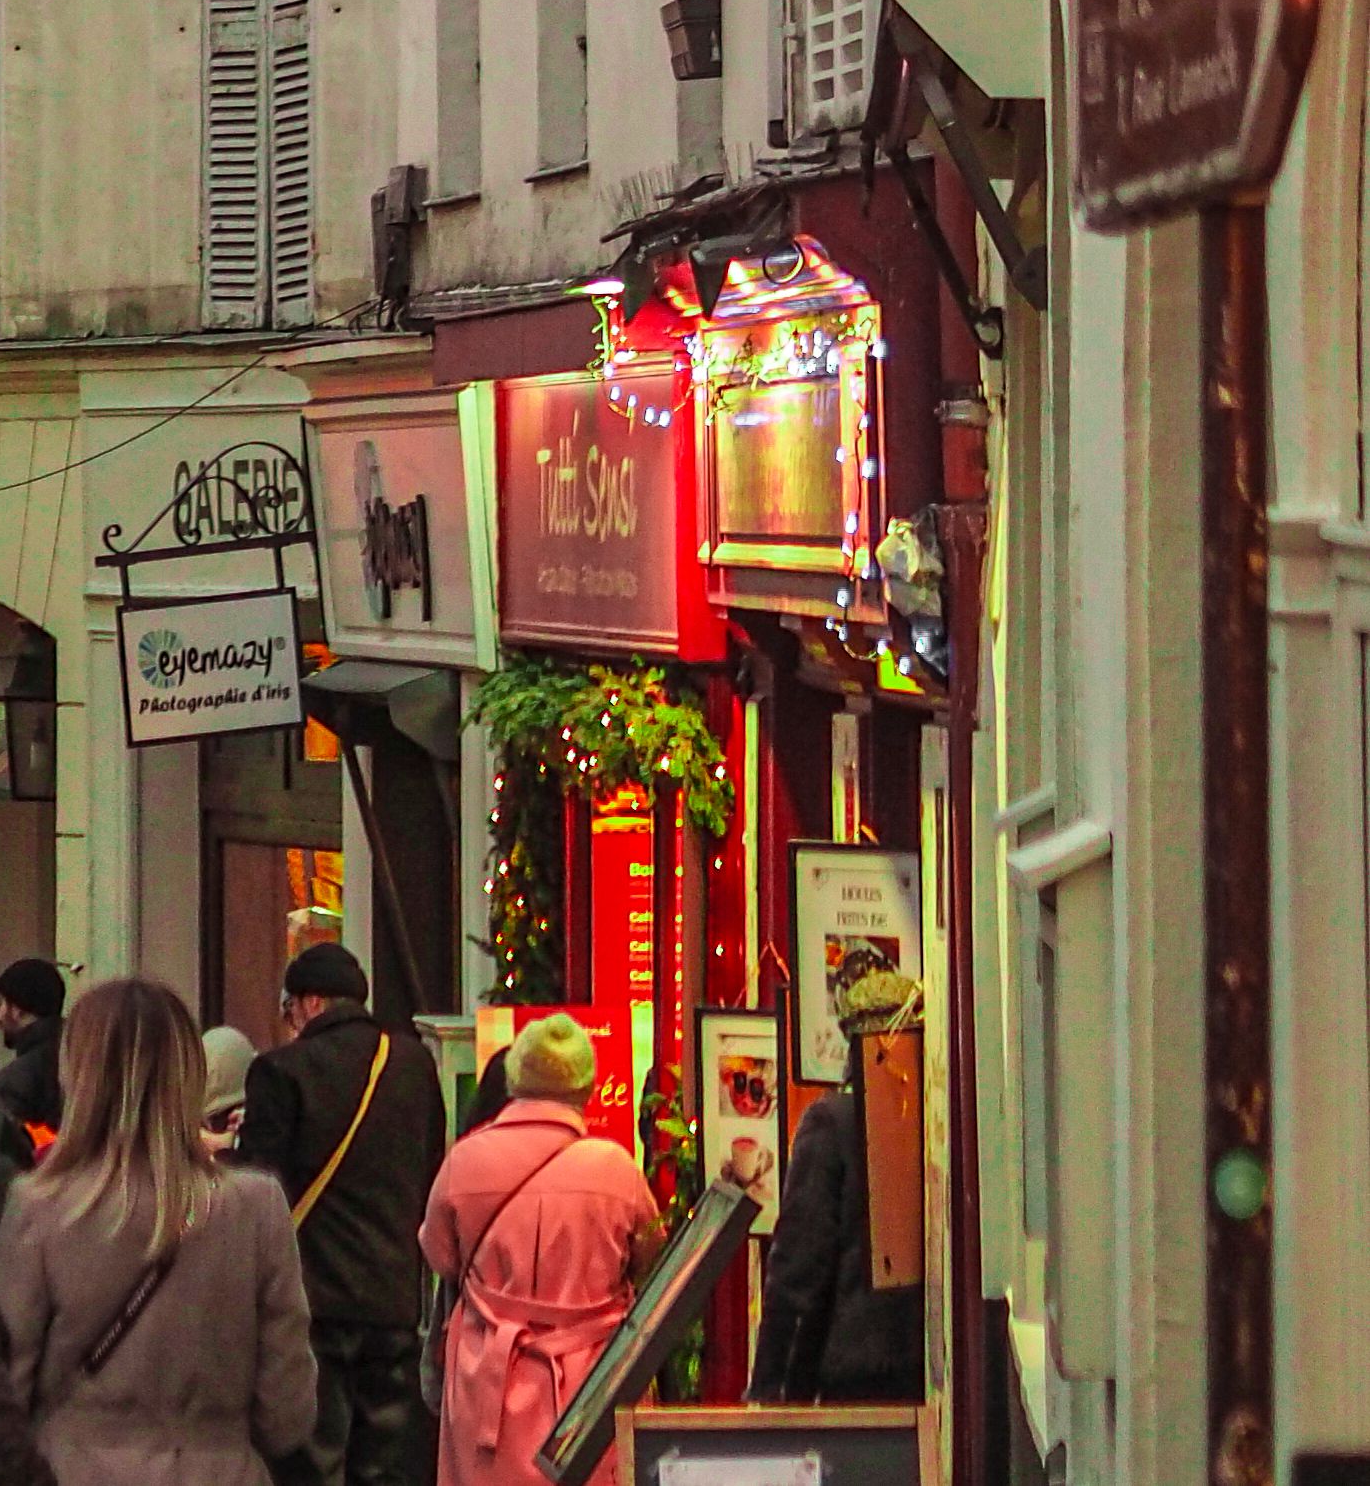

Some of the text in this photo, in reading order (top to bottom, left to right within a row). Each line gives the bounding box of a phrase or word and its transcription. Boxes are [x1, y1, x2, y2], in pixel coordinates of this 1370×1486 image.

[174, 458, 299, 536] GALERIE
[139, 682, 292, 715] Photographie d'iris
